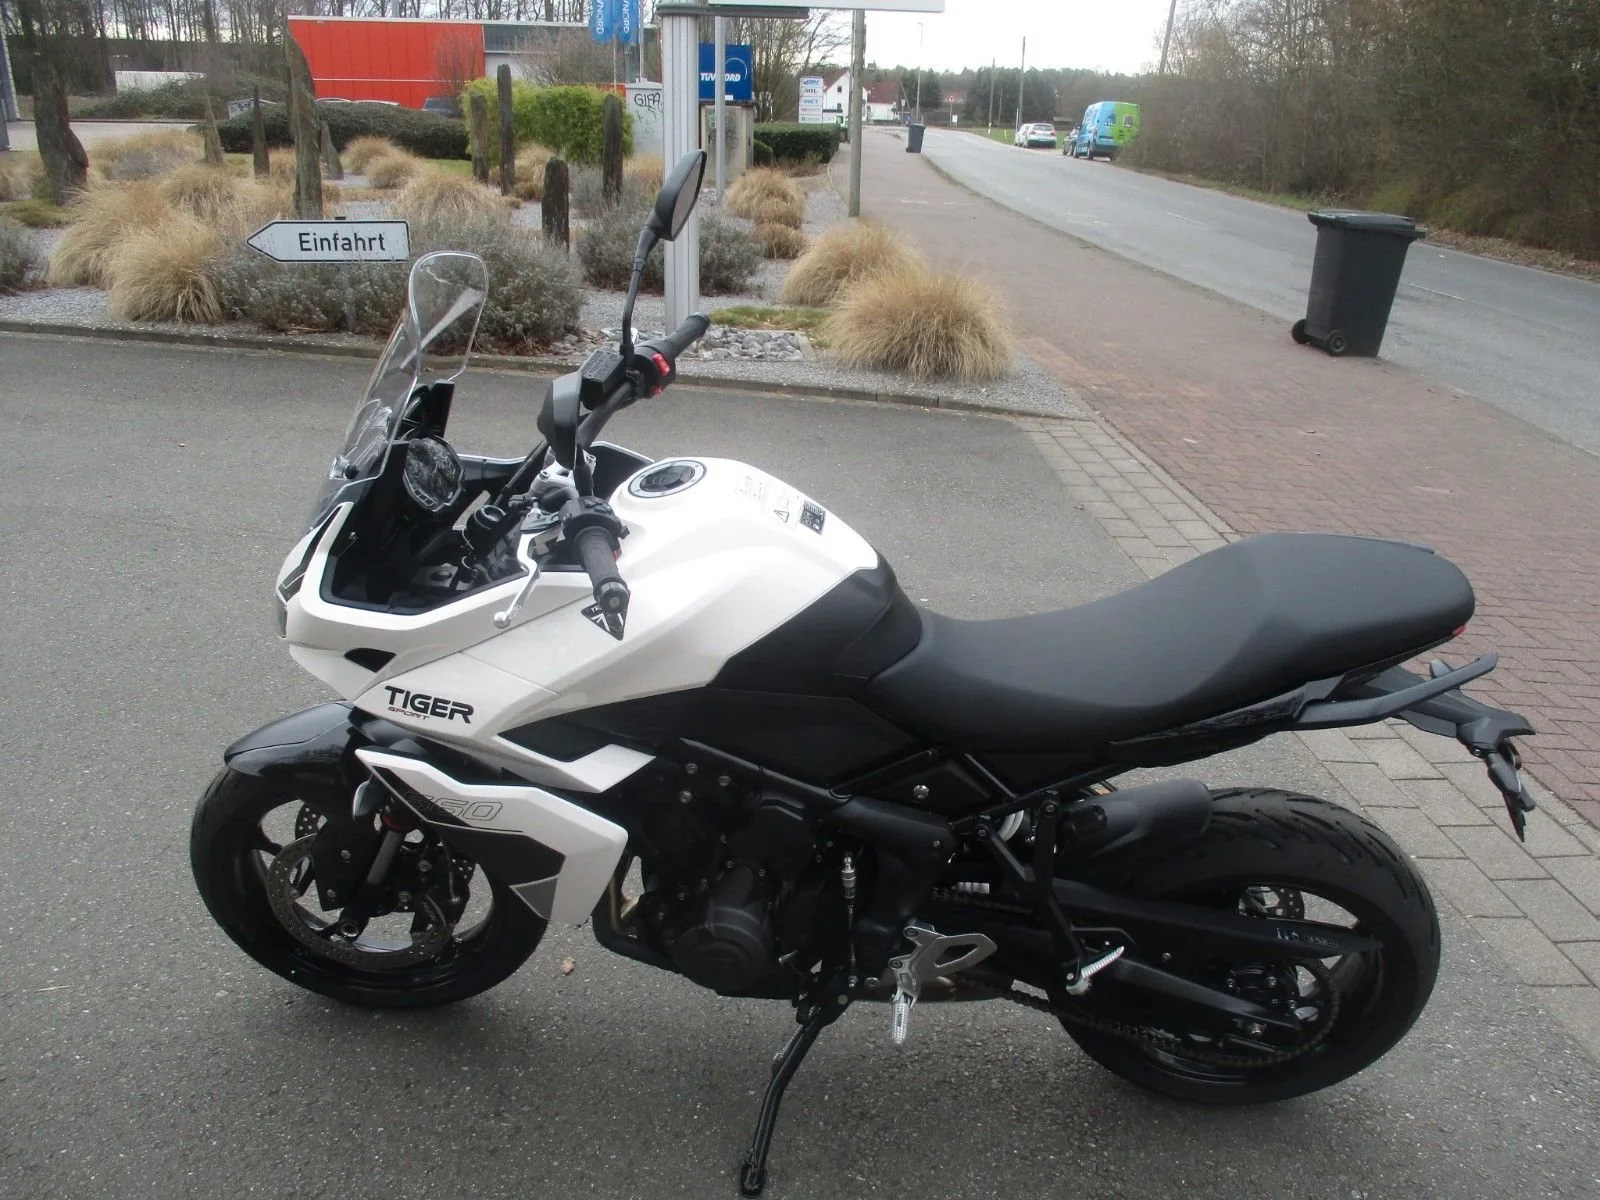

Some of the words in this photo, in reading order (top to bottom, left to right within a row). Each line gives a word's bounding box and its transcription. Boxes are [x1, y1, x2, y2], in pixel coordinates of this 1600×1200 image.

[725, 73, 741, 82] ORD
[298, 232, 386, 252] Einfahrt
[384, 685, 474, 724] TIGER
[387, 706, 430, 720] SPORT
